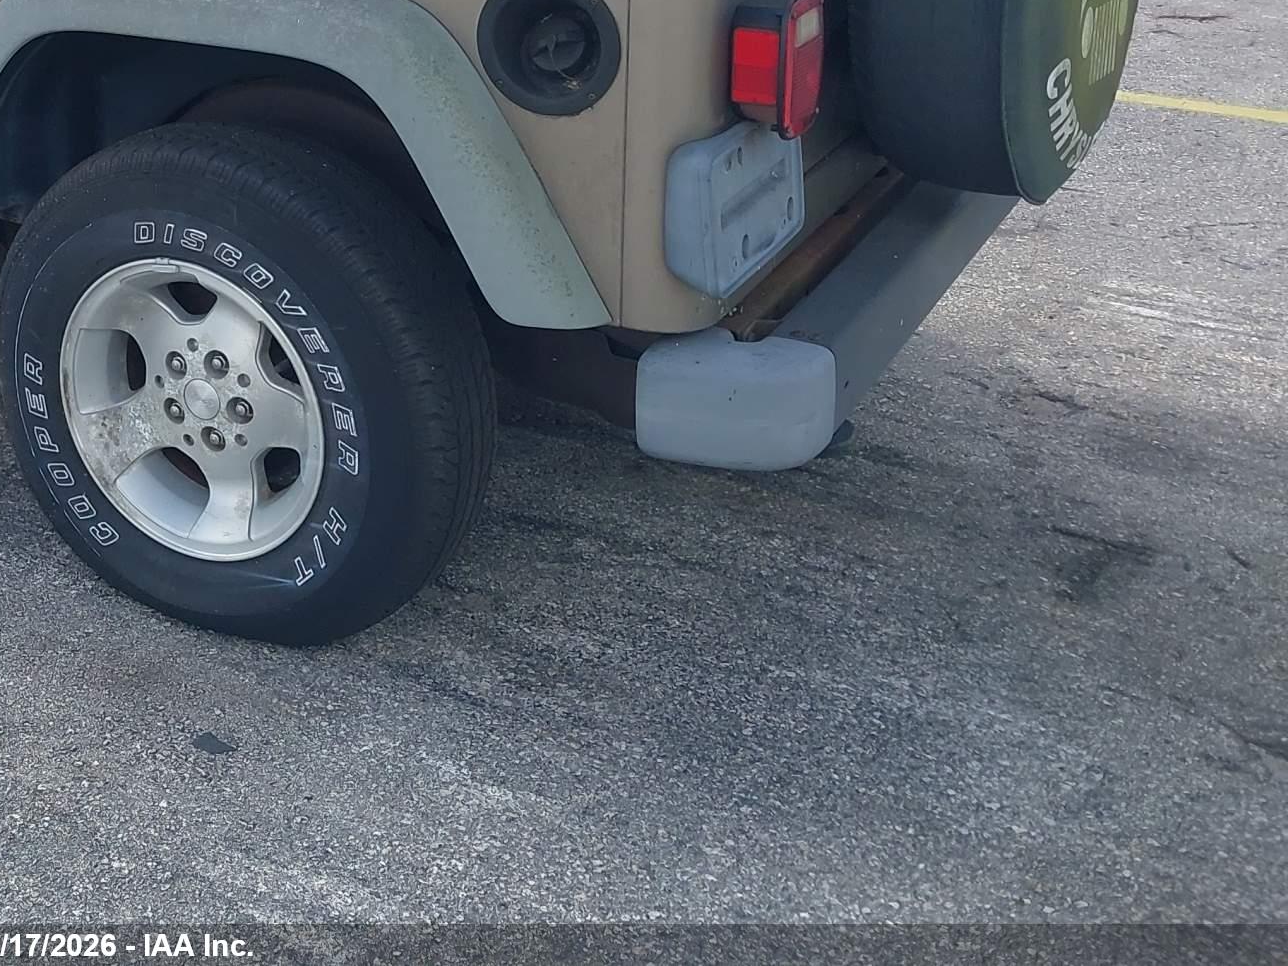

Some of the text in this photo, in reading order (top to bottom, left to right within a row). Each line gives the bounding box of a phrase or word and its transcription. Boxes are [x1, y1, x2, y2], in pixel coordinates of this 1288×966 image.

[23, 353, 120, 546] COOPER
[134, 221, 359, 586] DISCOVERER H/T
